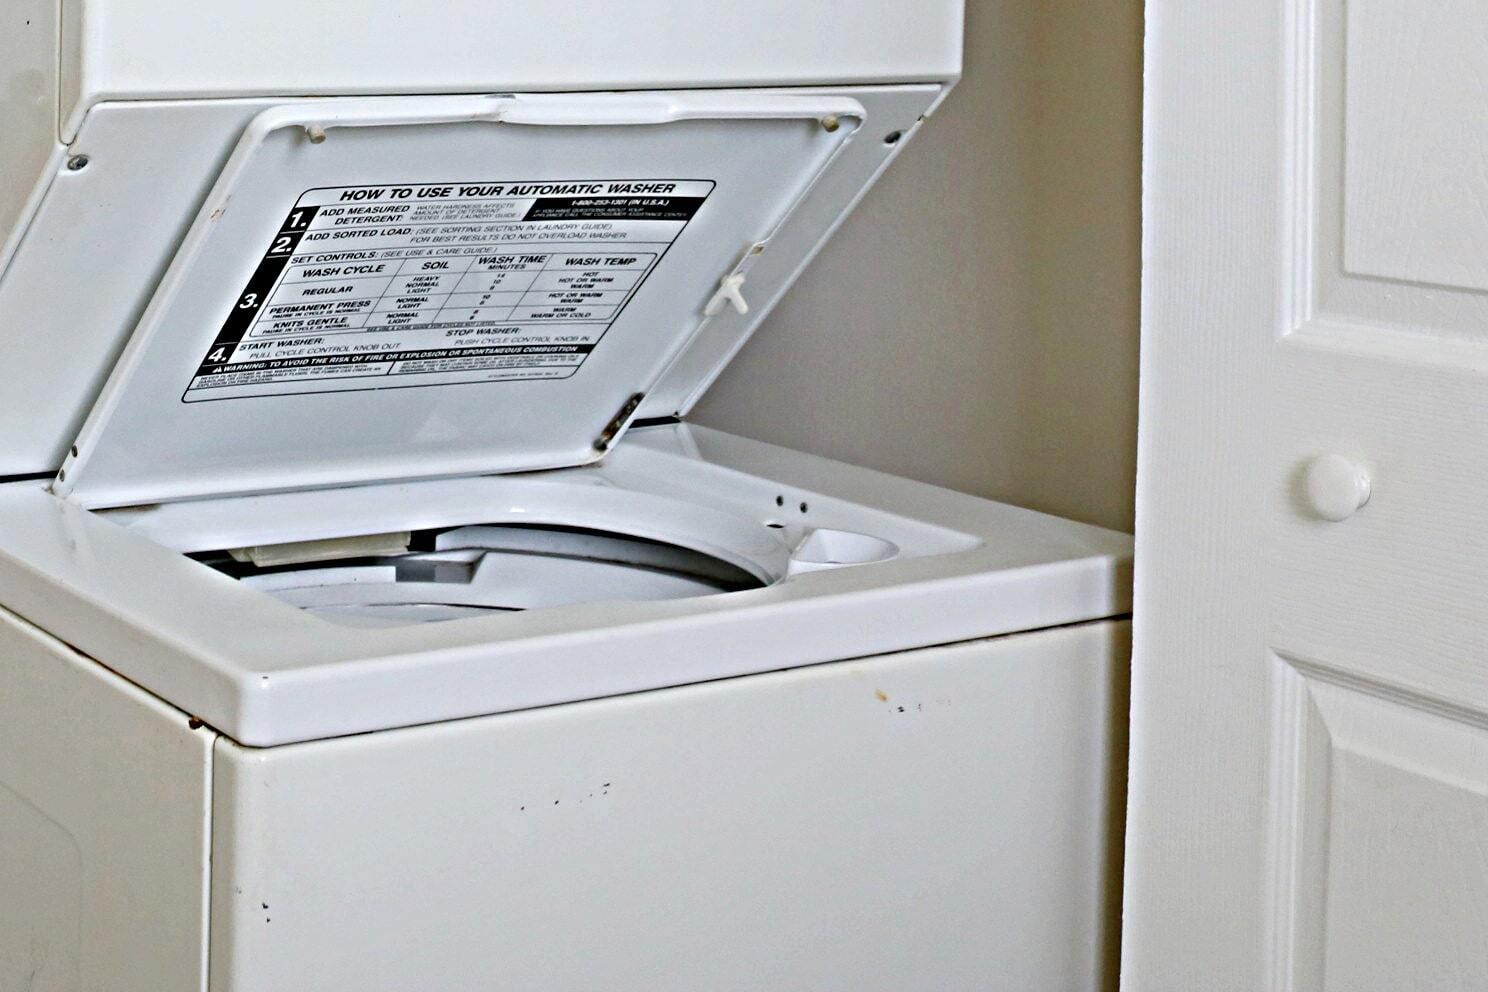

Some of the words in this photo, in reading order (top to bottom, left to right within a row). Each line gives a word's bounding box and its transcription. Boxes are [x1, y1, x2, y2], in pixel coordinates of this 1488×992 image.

[339, 189, 385, 201] HOW
[390, 188, 413, 199] TO
[417, 187, 454, 198] USE
[458, 186, 505, 197] YOUR
[506, 184, 603, 196] AUTOMATIC
[607, 183, 676, 194] WASHER
[320, 208, 345, 217] ADD
[347, 205, 410, 214] MEASURED
[290, 211, 307, 228] 1.
[305, 232, 331, 241] ADD
[332, 229, 378, 239] SORTED
[483, 225, 523, 233] SECTION
[432, 235, 457, 243] BEST
[458, 234, 500, 242] RESULTS
[271, 237, 292, 253] 2.
[291, 255, 314, 264] SET
[315, 251, 379, 263] CONTROLS:
[380, 250, 404, 258] (SEE
[478, 256, 515, 265] WASH
[518, 255, 547, 264] TIME
[565, 258, 601, 266] WASH
[604, 257, 637, 266] TEMP
[302, 266, 341, 278] WASH
[343, 264, 386, 275] CYCLE
[421, 261, 449, 270] SOIL
[302, 286, 353, 296] REGULAR
[239, 293, 259, 309] 3.
[269, 303, 335, 314] PERMANENT
[336, 300, 372, 309] PRESS
[273, 320, 304, 329] KNITS
[306, 316, 349, 327] GENTLE
[445, 328, 474, 336] STOP
[239, 342, 273, 351] START
[276, 337, 325, 347] WASHER:
[208, 347, 227, 362] 4.
[249, 350, 272, 359] PULL
[274, 348, 309, 357] CYCLE
[311, 345, 351, 354] CONTROL
[353, 344, 378, 352] KNOB
[223, 362, 267, 372] WARNING:
[281, 358, 308, 366] AVOID
[400, 350, 447, 359] EXPLOSION
[462, 347, 522, 355] SPONTANEOUS
